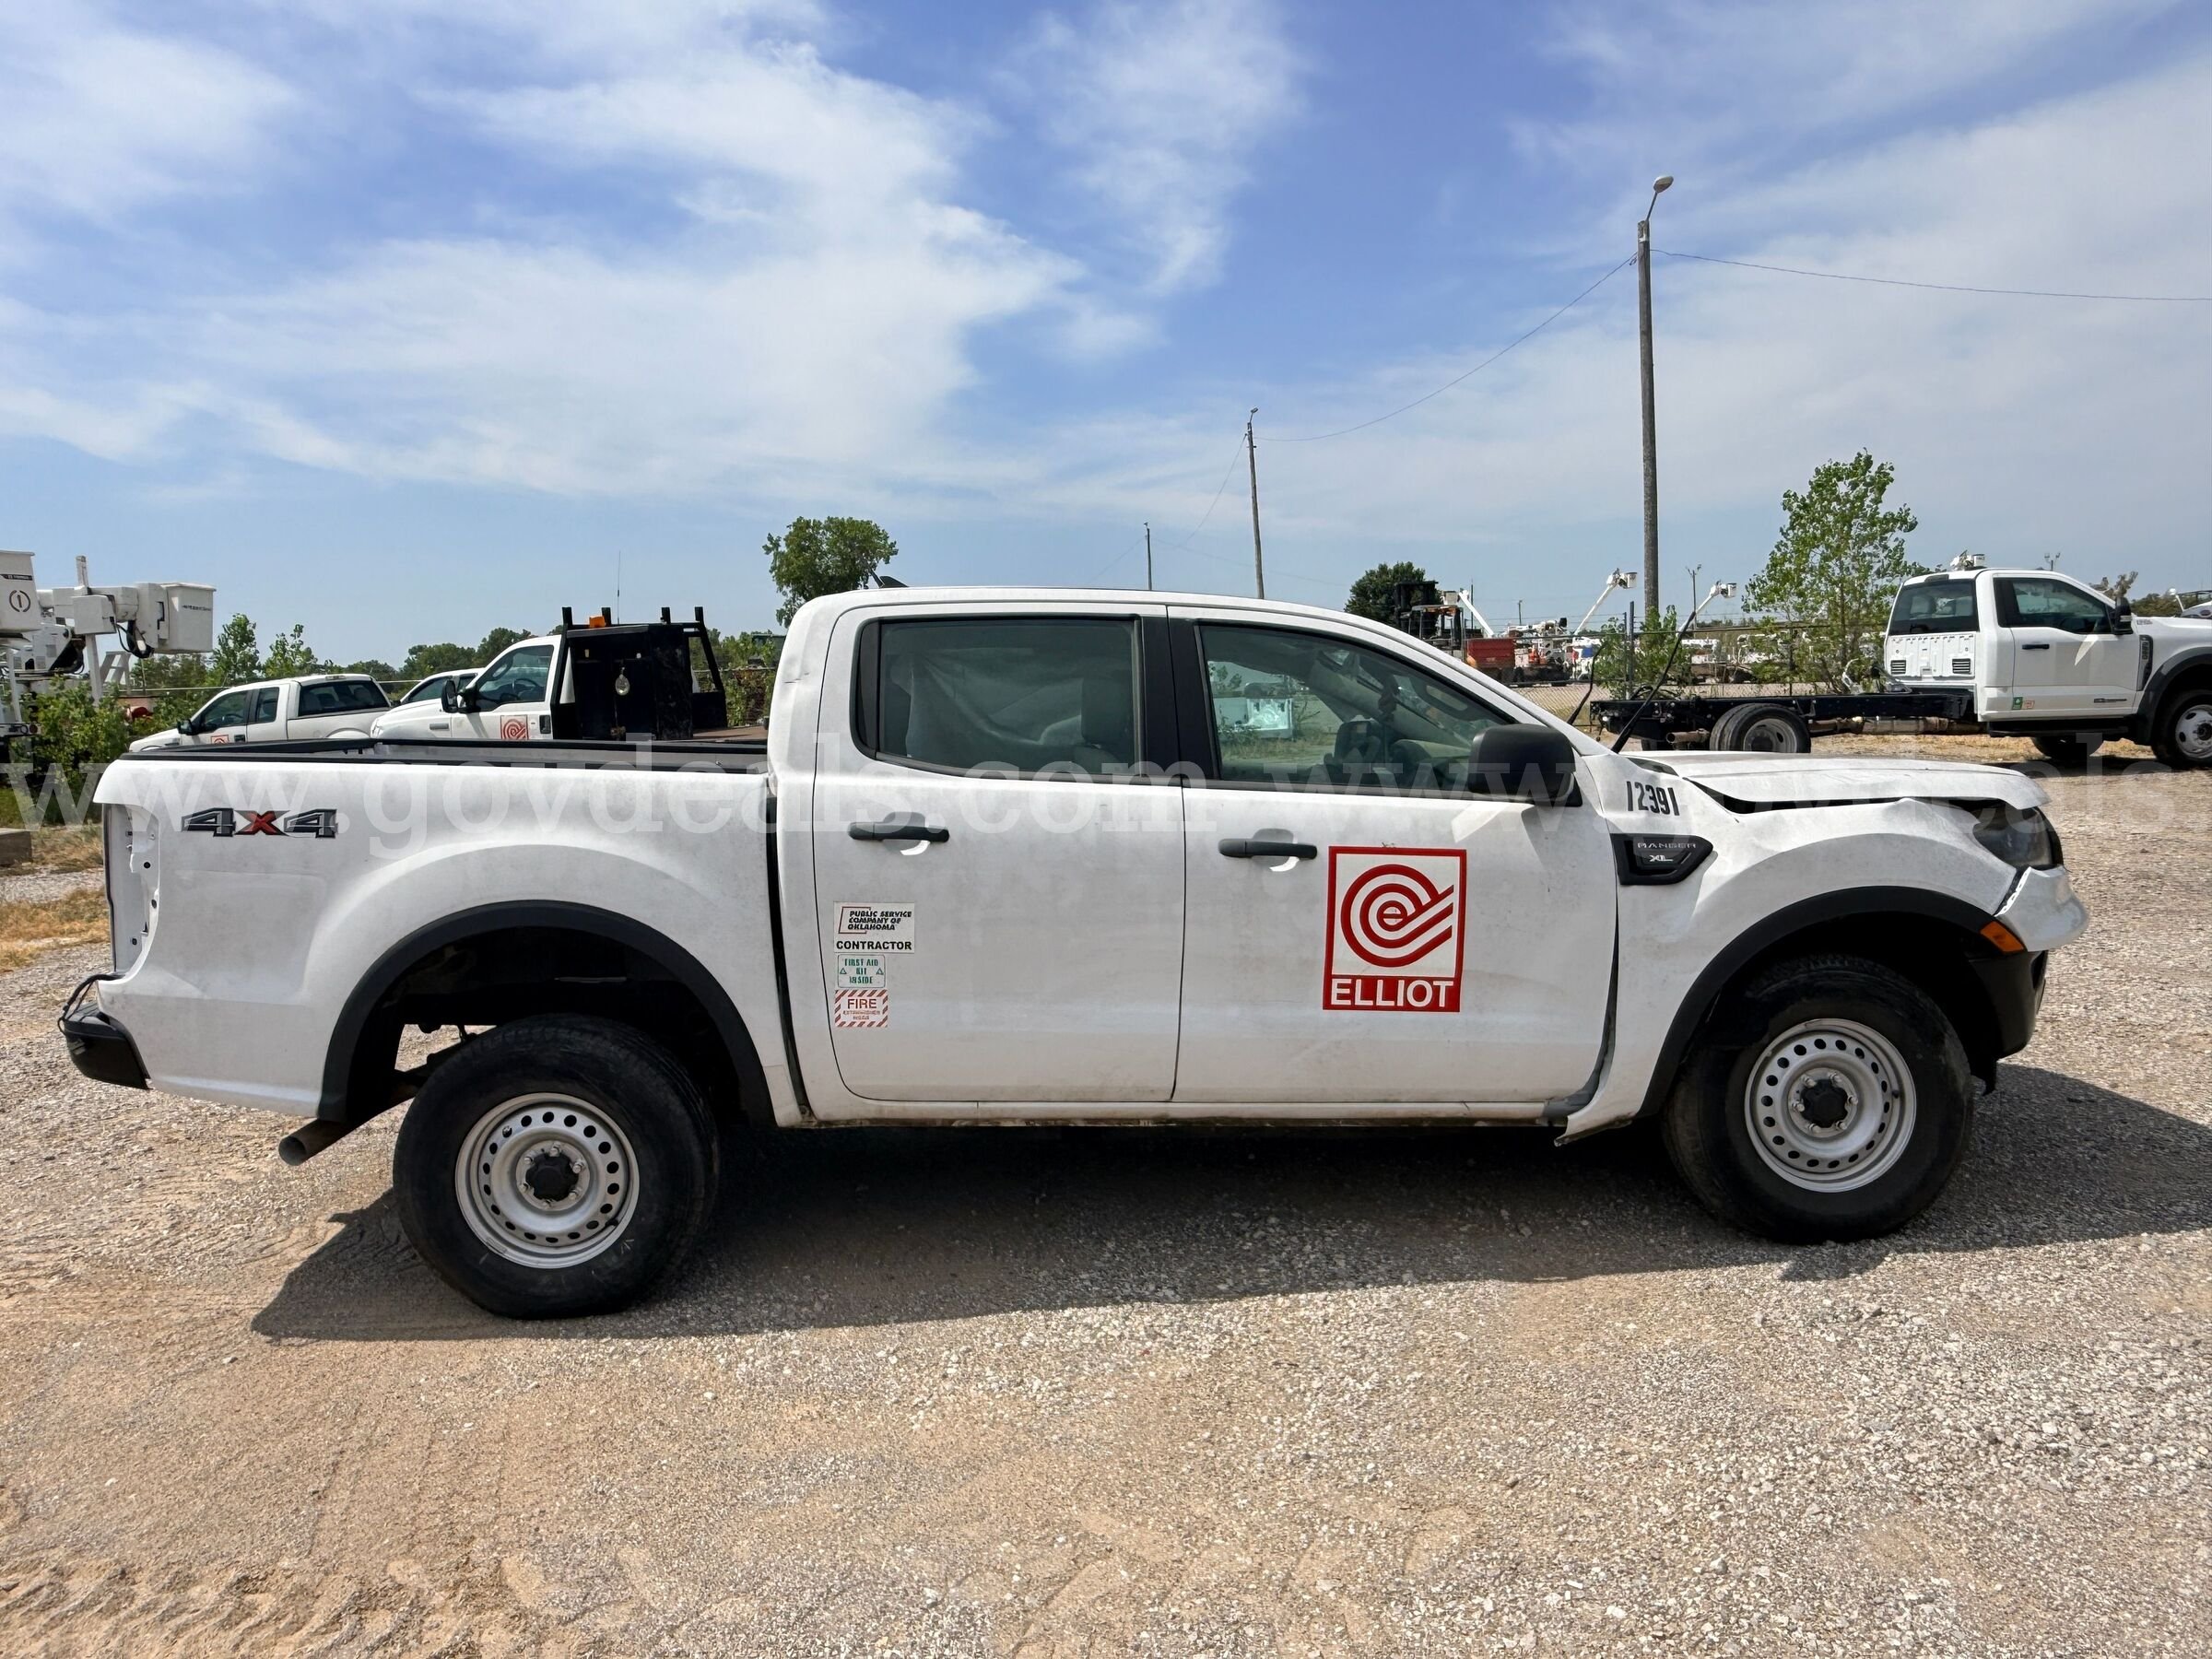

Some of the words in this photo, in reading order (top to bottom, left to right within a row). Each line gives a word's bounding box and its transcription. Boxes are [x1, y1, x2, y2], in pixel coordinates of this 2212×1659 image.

[1626, 781, 1680, 816] 12391
[1649, 853, 1674, 863] XL
[836, 940, 912, 951] CONTRACTOR
[844, 958, 865, 967] FIRST
[865, 959, 879, 967] AID
[1330, 977, 1454, 1008] ELLIOT
[847, 998, 877, 1009] FIRE
